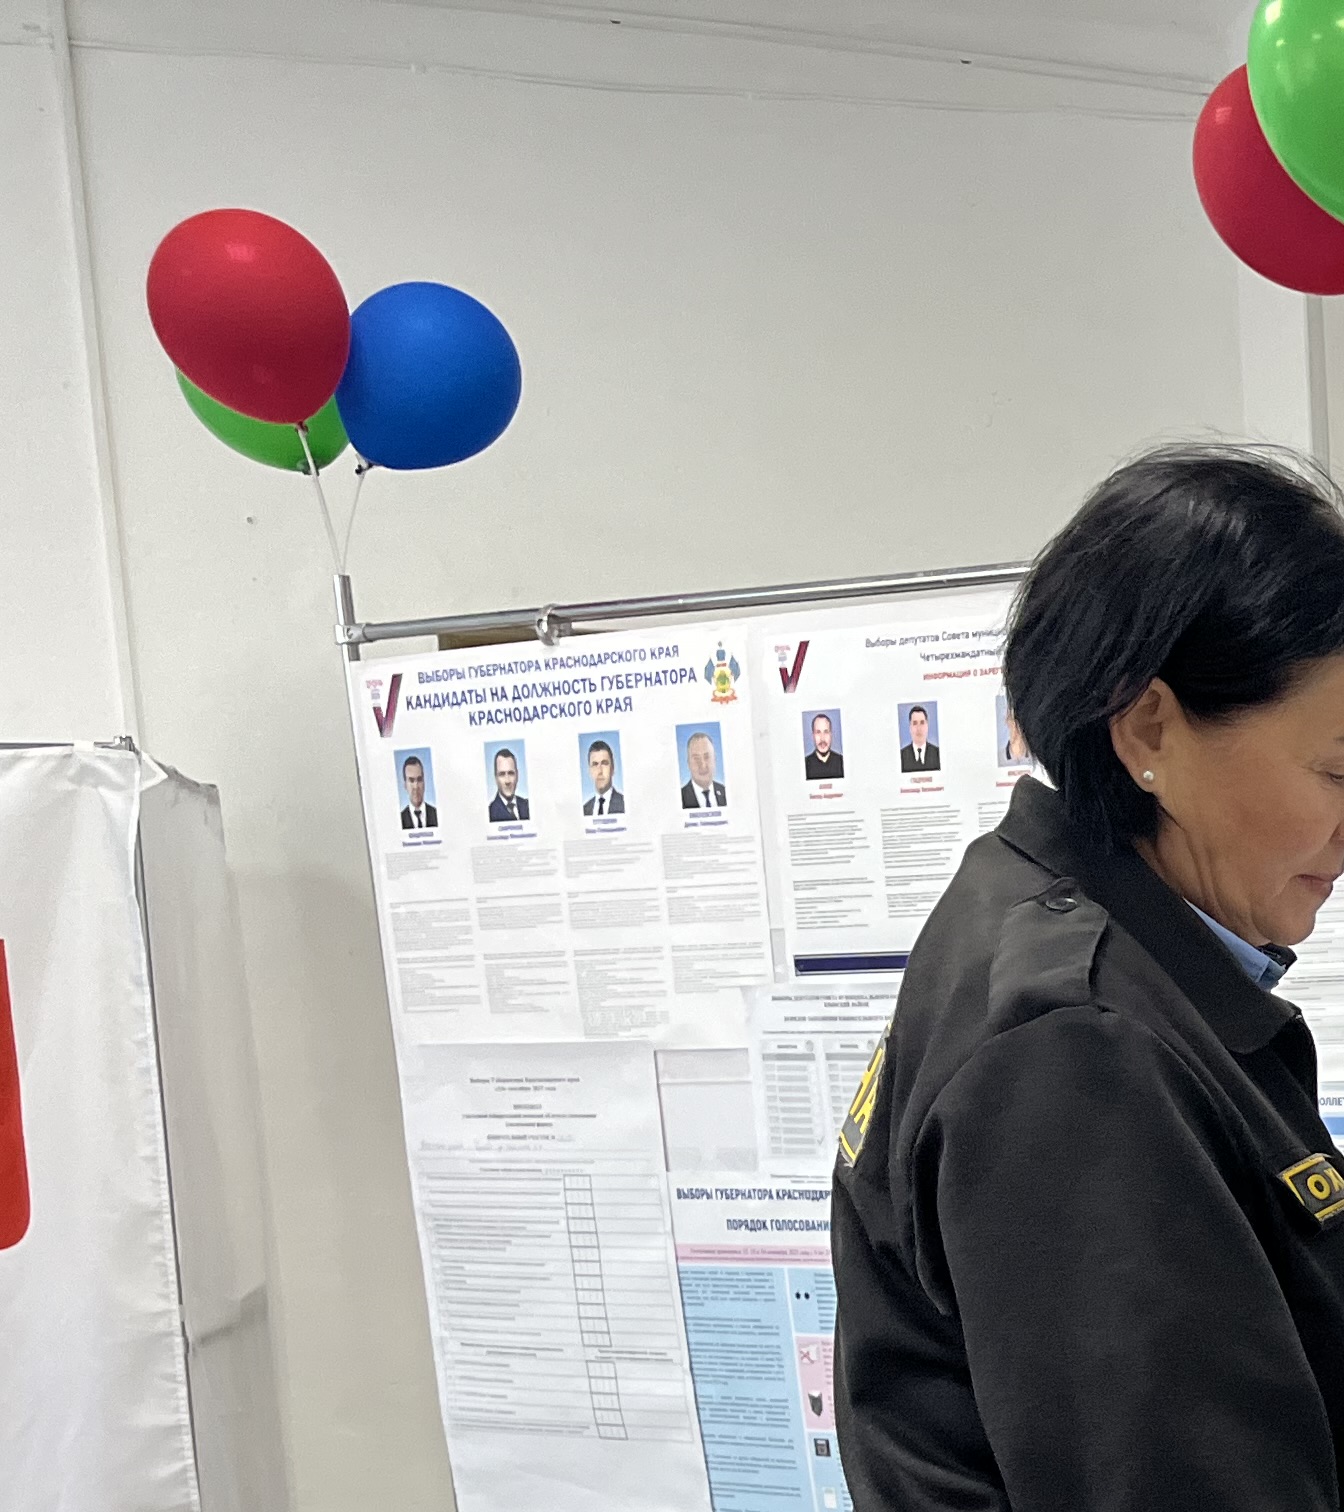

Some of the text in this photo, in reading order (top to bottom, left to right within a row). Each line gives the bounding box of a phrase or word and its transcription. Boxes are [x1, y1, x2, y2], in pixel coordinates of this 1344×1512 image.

[418, 645, 679, 684] ВЫБОРЫ ГУБЕРНАТОРА КРАСНОДАРСКОГО КРАЯ
[405, 687, 487, 711] КАНДИДАТЫ
[491, 684, 508, 702] НА
[511, 678, 597, 703] ДОЛЖНОСТЬ
[601, 667, 697, 691] ГУБЕРНАТОРА
[469, 696, 633, 727] КРАСНОДАРСКОГО КРАЯ
[676, 1187, 833, 1202] ВЫБОРЫ ГУБЕРНАТОРА КРАСНОДАР
[726, 1218, 832, 1232] ПОРЯДОК ГОЛОСОВАНИ
